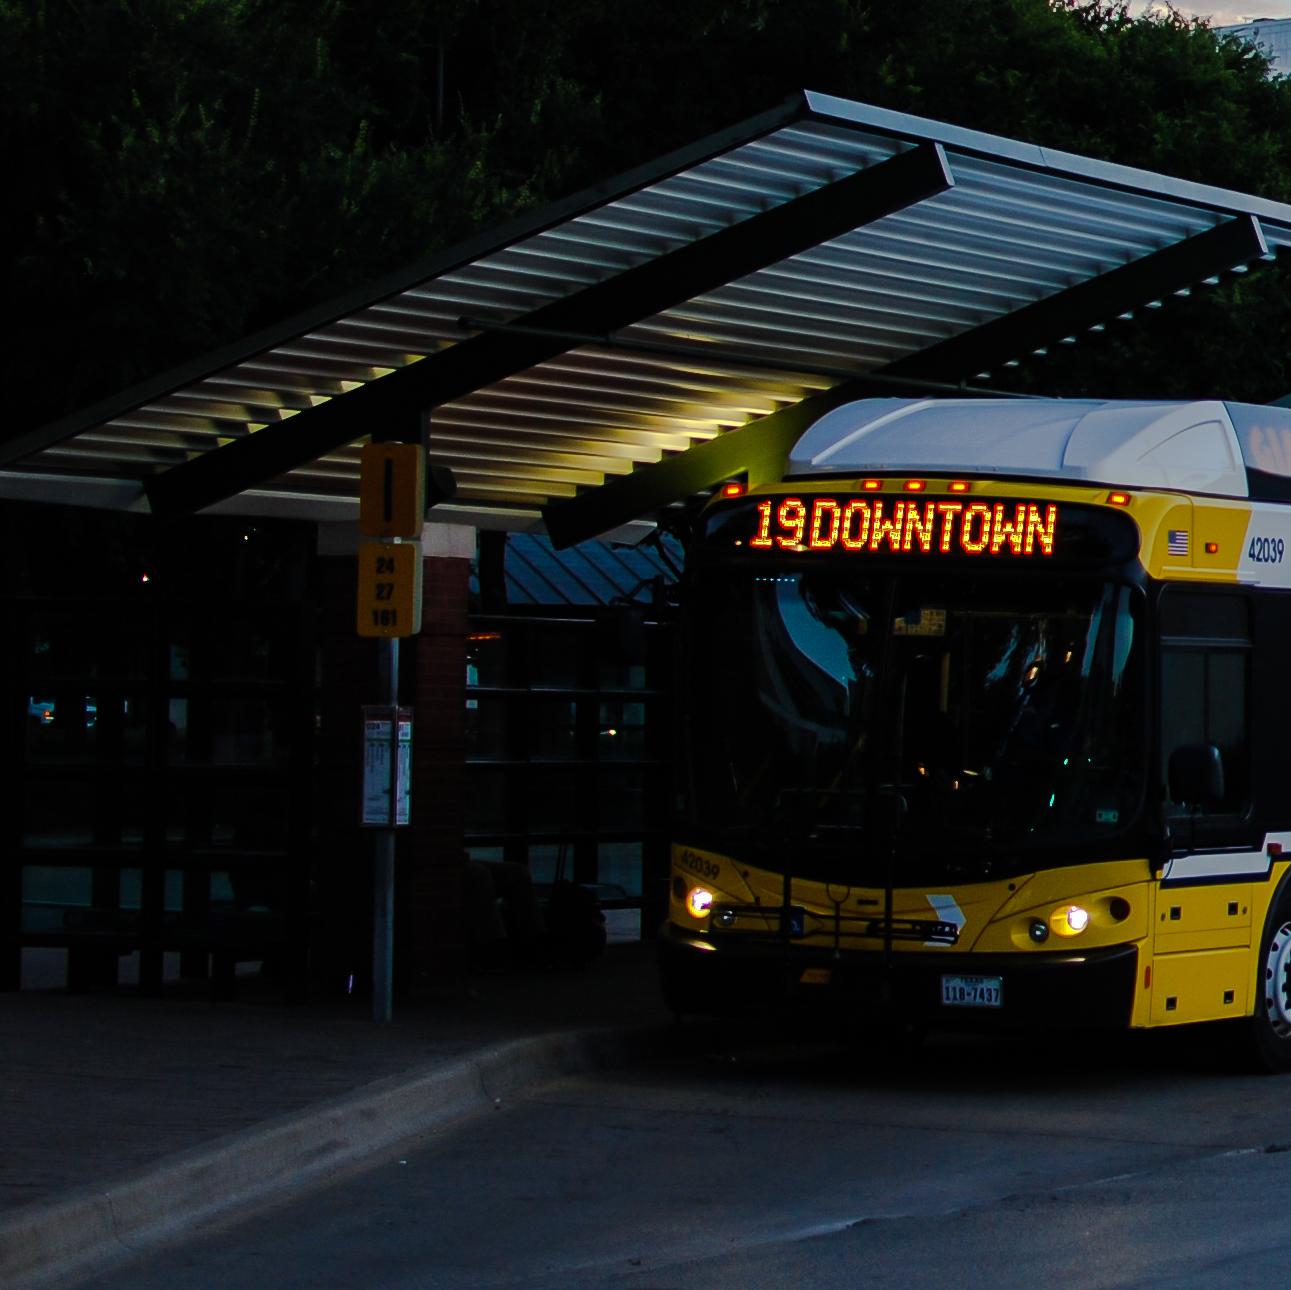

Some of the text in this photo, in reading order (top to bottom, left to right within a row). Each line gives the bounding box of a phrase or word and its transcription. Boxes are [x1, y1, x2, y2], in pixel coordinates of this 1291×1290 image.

[750, 499, 1058, 555] 19 DOWNTOWN
[1248, 536, 1285, 564] 42039
[375, 557, 395, 574] 24
[375, 582, 395, 600] 27
[371, 608, 397, 626] 161
[682, 850, 720, 880] 42039
